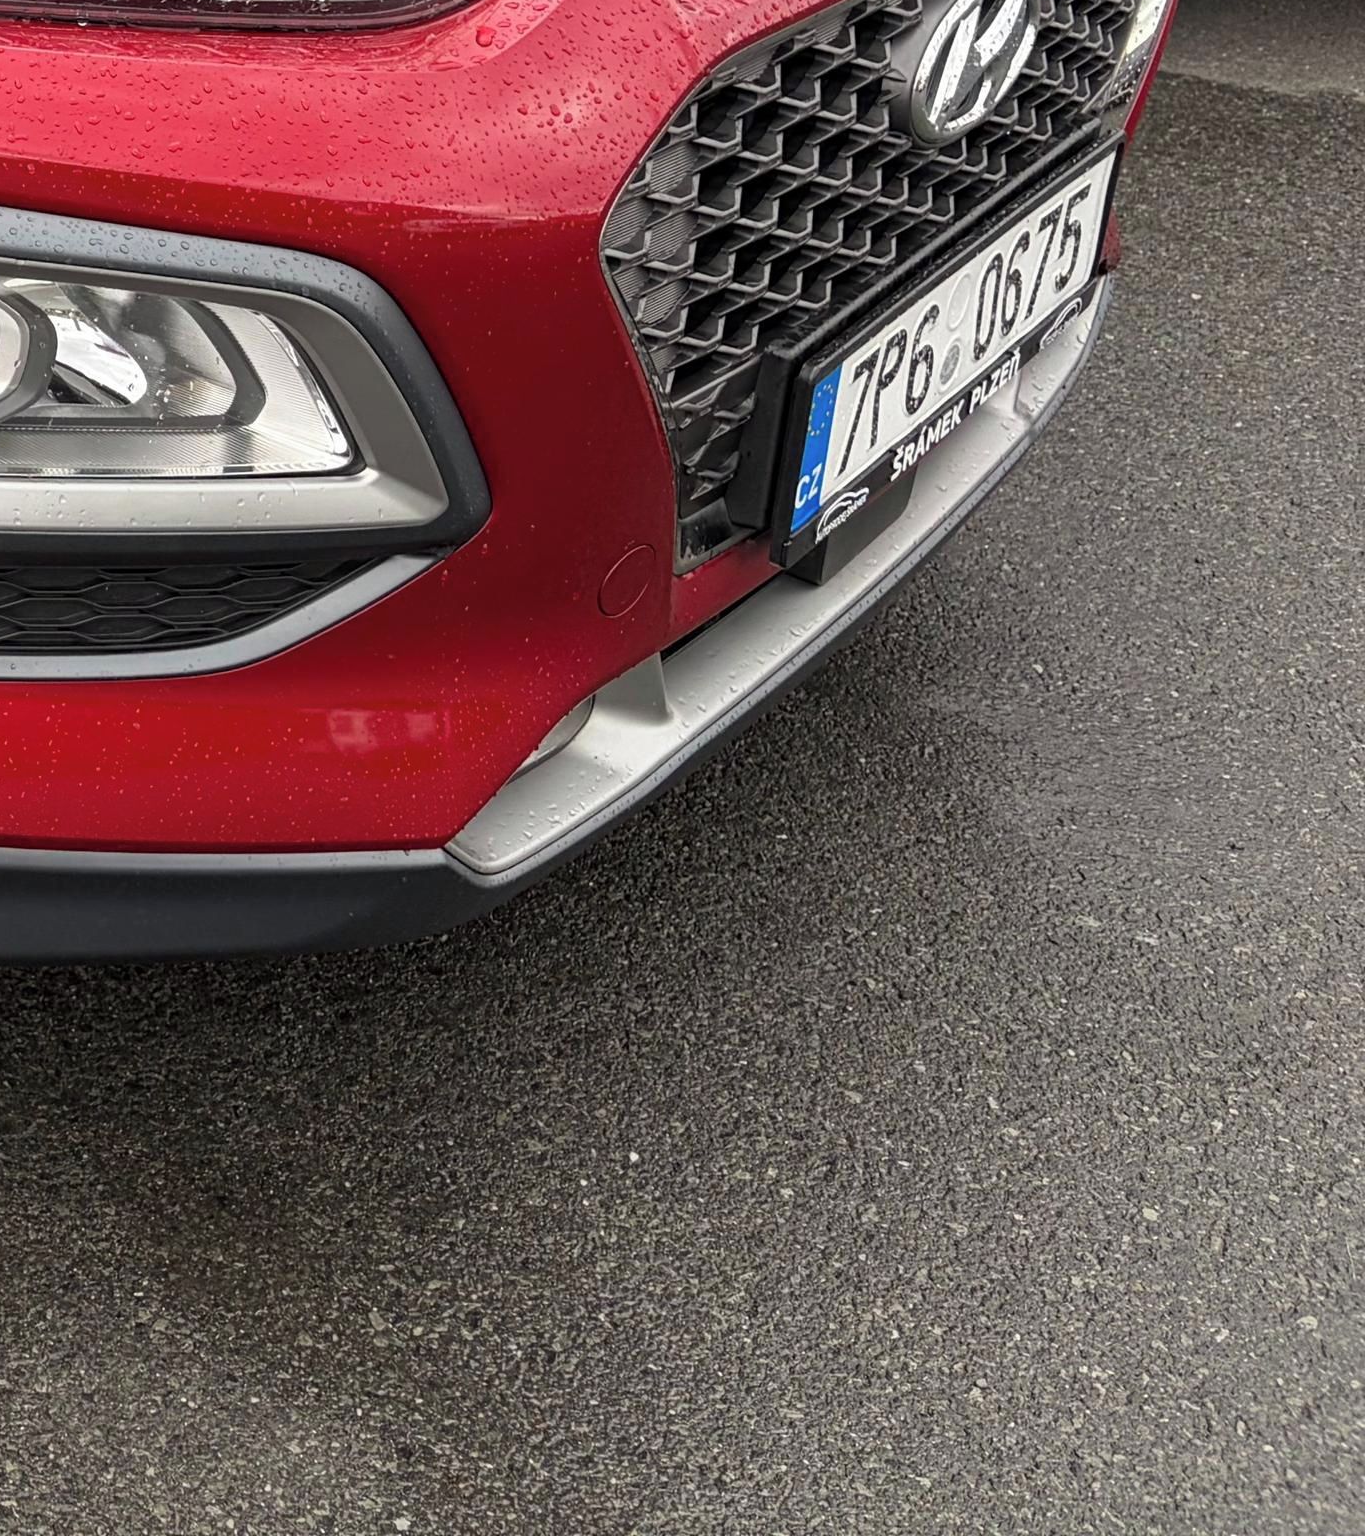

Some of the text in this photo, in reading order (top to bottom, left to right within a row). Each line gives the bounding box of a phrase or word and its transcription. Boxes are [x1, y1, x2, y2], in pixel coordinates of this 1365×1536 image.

[836, 183, 1092, 477] 7P6 0675
[890, 346, 1021, 482] ŠRÁMEK PLZEŇ
[795, 463, 822, 509] CZ
